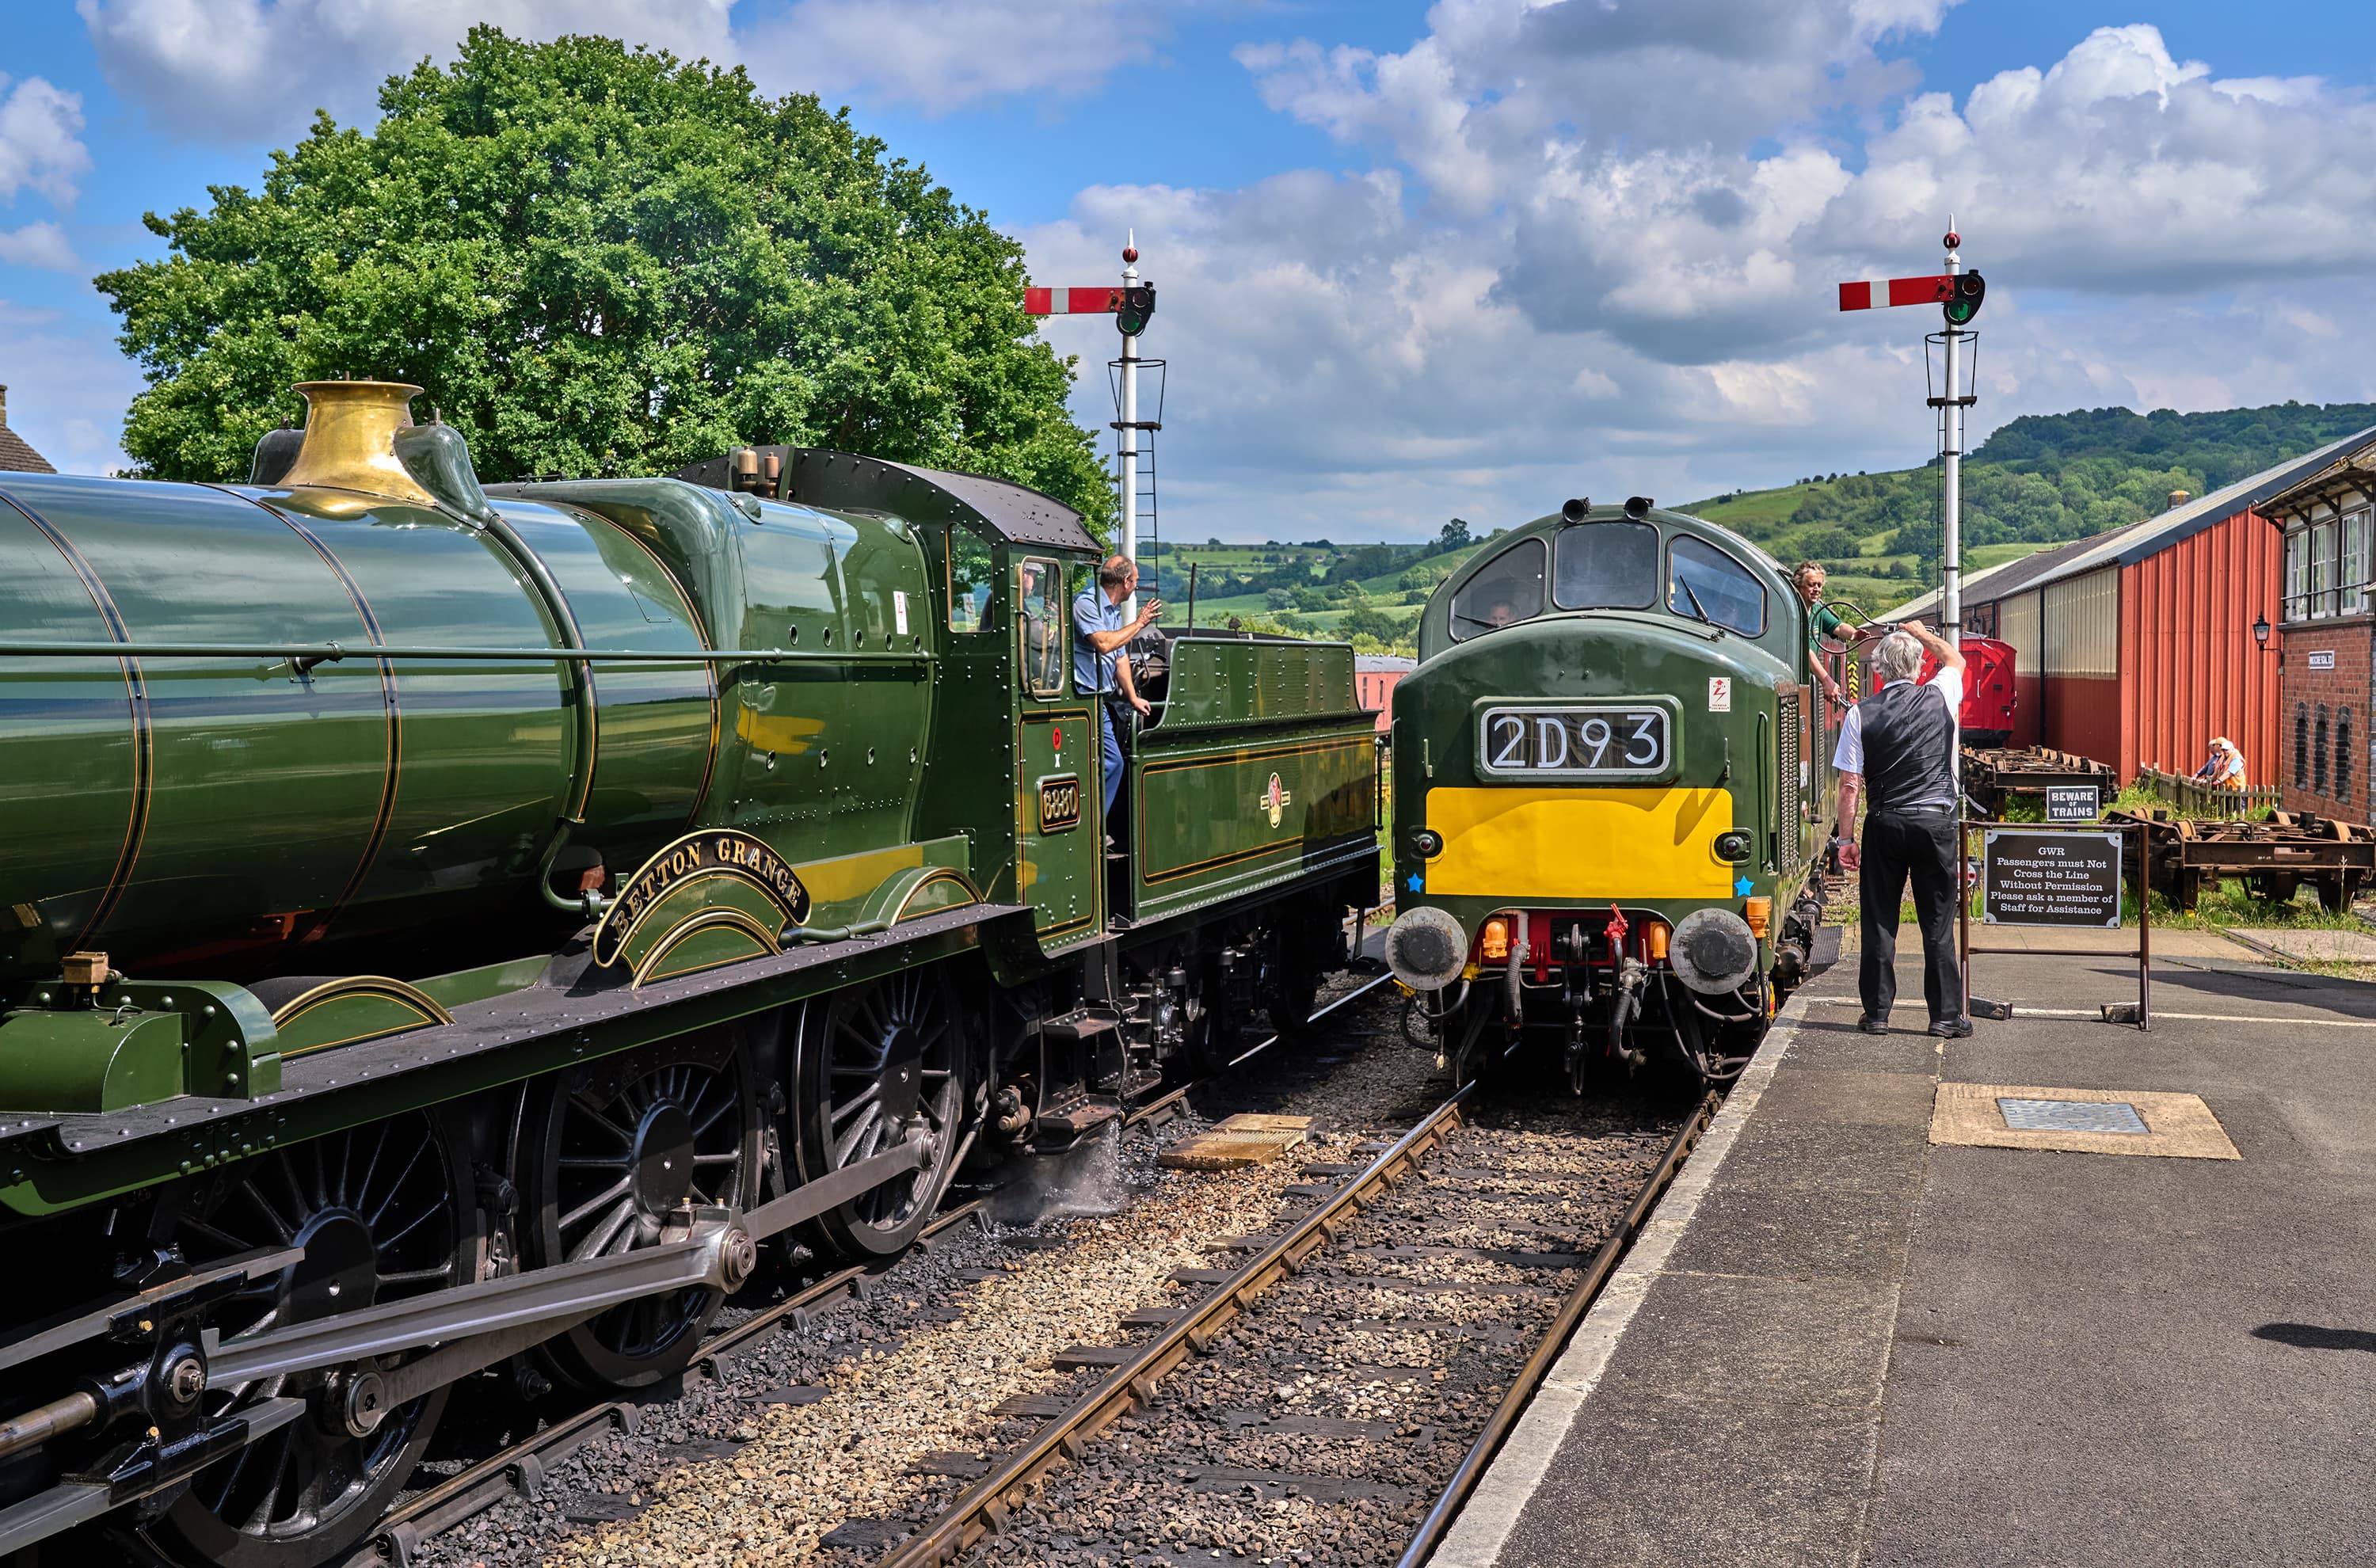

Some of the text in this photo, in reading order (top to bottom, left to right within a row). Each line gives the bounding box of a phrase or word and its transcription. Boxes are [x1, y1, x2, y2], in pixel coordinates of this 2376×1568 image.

[1492, 714, 1658, 768] 2D93
[1055, 753, 1060, 768] X
[2051, 792, 2094, 801] BEWARE
[1044, 786, 1077, 820] 6880
[2052, 807, 2093, 816] TRAINS
[2038, 847, 2066, 856] GWR
[1997, 857, 2108, 869] Passengers must Not
[2013, 869, 2090, 880] Cross the Line
[611, 838, 802, 943] BETTON GRANGE
[2000, 880, 2104, 892] Without Permission
[1990, 891, 2024, 900] Please
[2026, 892, 2046, 901] ask
[2055, 894, 2100, 903] member
[2101, 895, 2114, 904] of
[2000, 903, 2103, 915] Staff for Assistance
